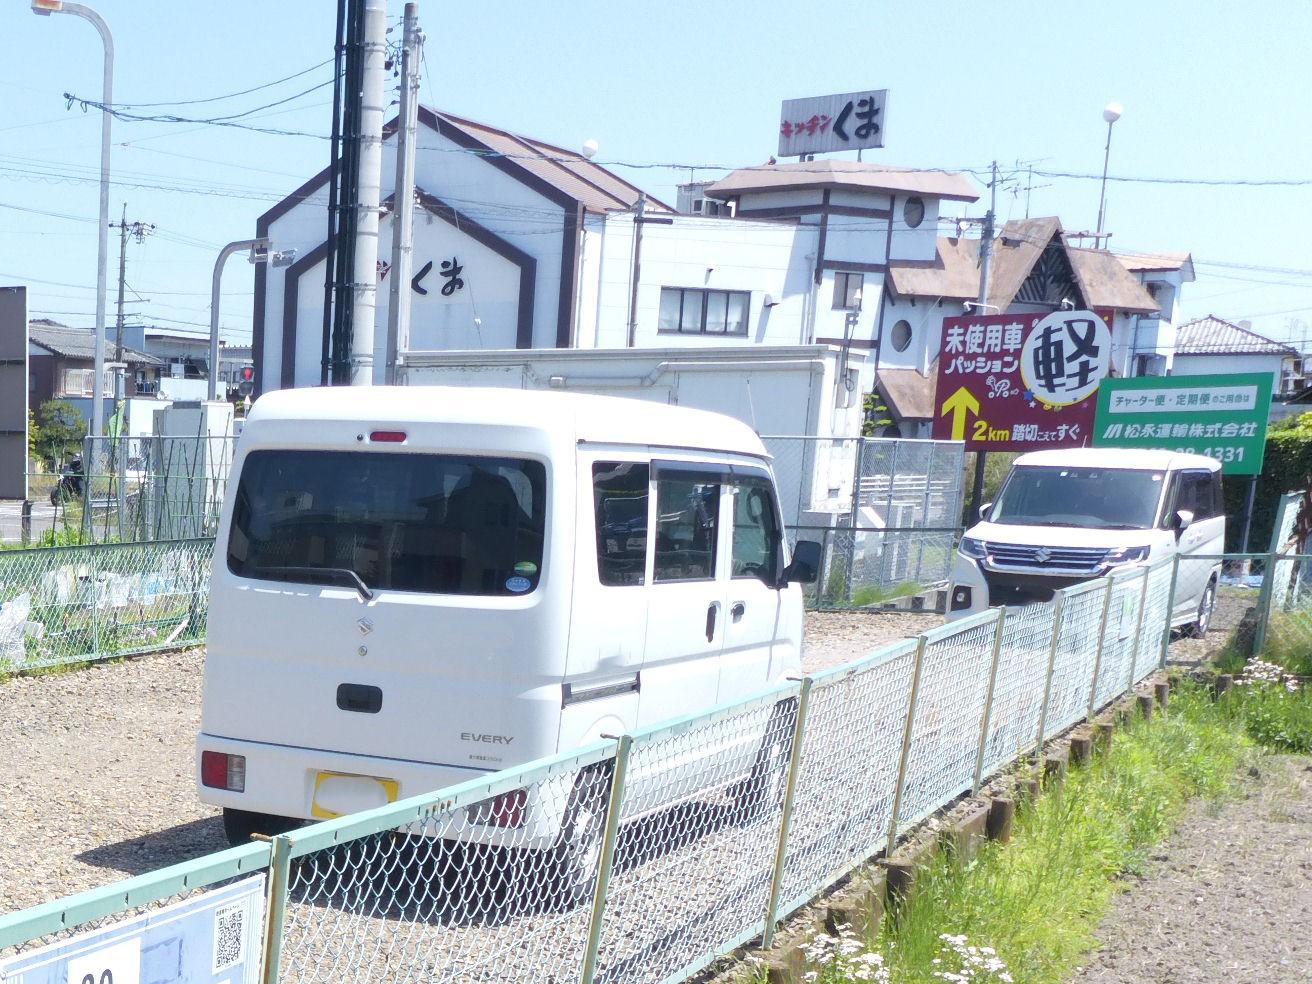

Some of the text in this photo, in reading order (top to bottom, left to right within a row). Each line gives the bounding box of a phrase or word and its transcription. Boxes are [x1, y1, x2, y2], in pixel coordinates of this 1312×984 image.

[833, 96, 880, 141] くま
[411, 257, 464, 296] くま
[945, 322, 1023, 353] 未使用車
[945, 355, 1018, 374] パッション
[1033, 319, 1100, 393] 軽
[972, 420, 1009, 441] 2km
[1124, 421, 1257, 439] 松永運輸株式会社
[461, 732, 514, 745] EVERY
